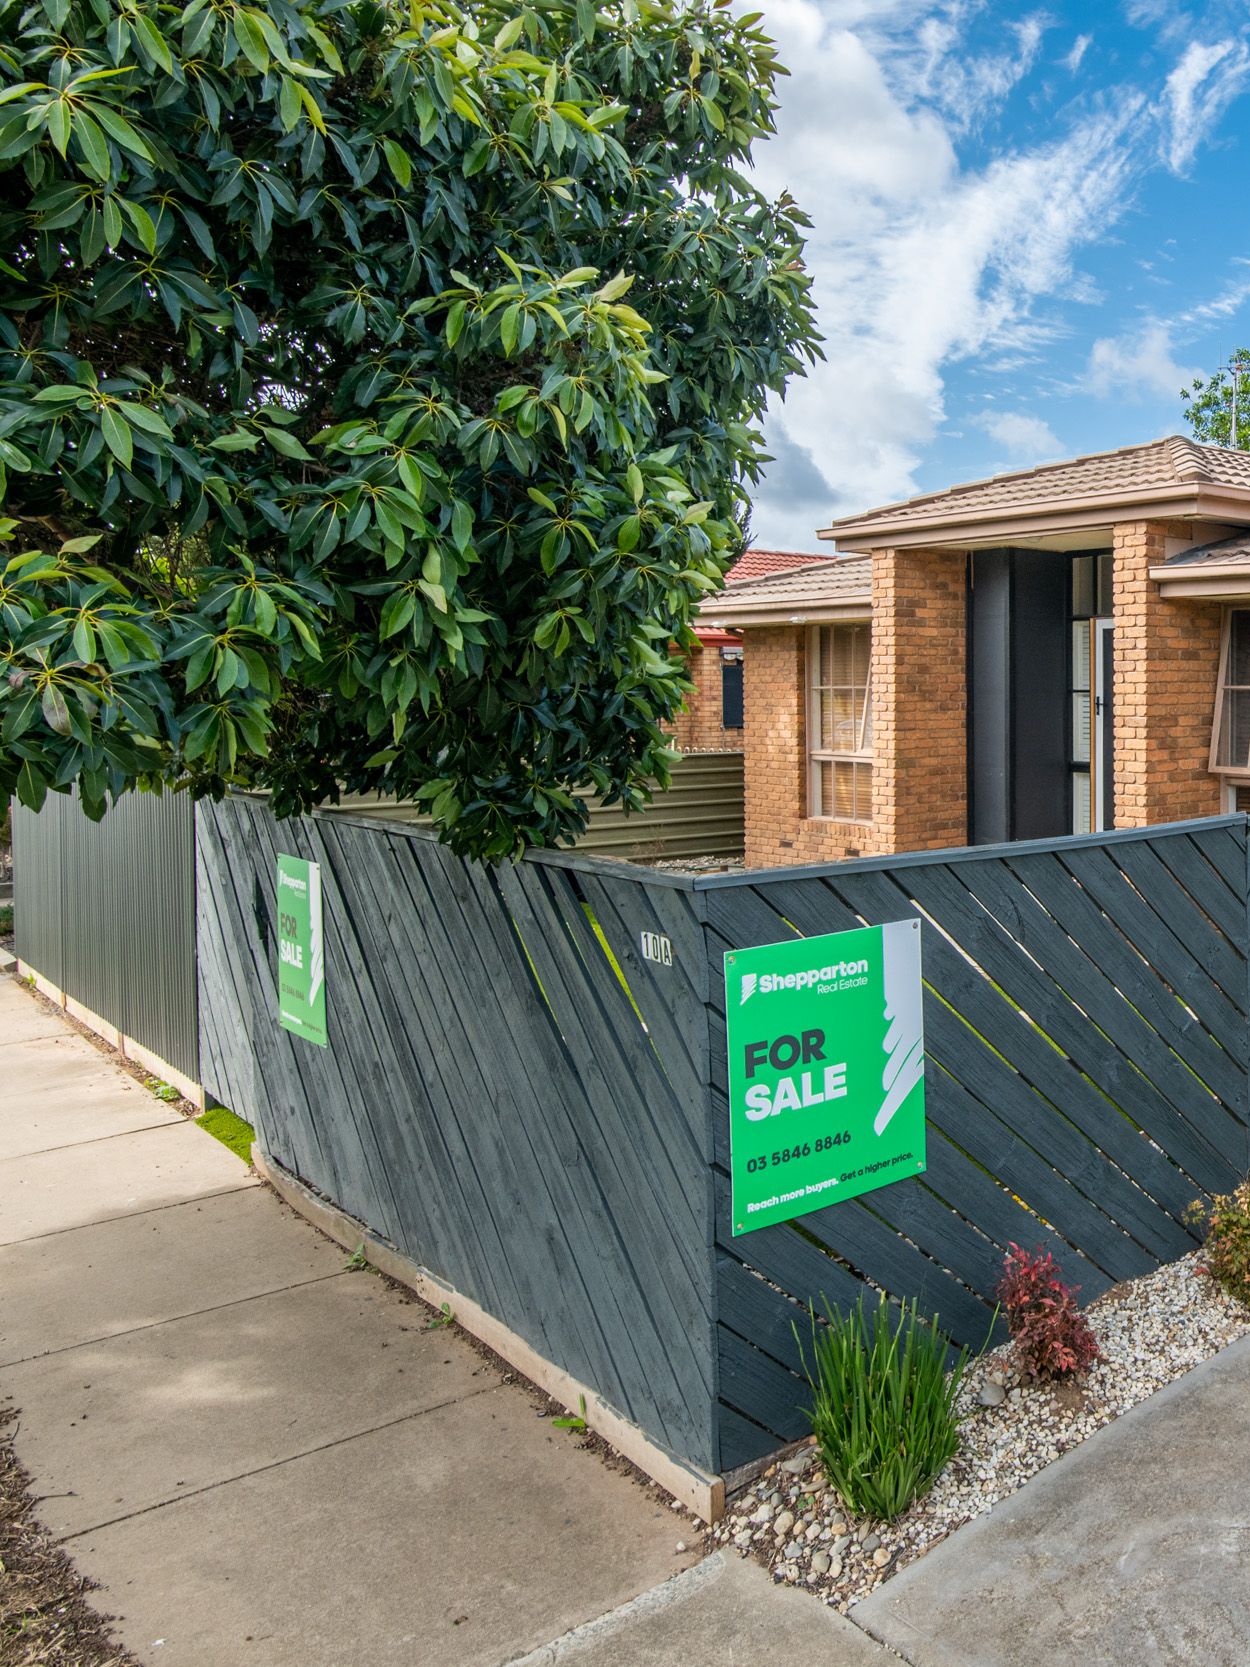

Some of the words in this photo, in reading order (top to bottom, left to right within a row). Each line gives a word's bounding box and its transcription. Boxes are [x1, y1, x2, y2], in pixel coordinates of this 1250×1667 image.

[280, 911, 298, 940] FOR
[280, 938, 303, 969] SALE
[643, 932, 672, 965] 10A
[758, 959, 869, 993] Shepparton
[817, 981, 838, 995] Real
[839, 976, 869, 990] Estate
[744, 1027, 828, 1080] FOR
[744, 1062, 848, 1122] SALE
[746, 1155, 767, 1174] 03
[771, 1142, 811, 1166] 5846
[814, 1130, 852, 1153] 8846
[747, 1195, 779, 1213] Reach
[780, 1187, 805, 1203] more
[806, 1177, 839, 1195] buyers.
[840, 1170, 857, 1182] Get
[857, 1169, 864, 1177] a
[864, 1159, 890, 1174] higher
[891, 1151, 914, 1166] price.
